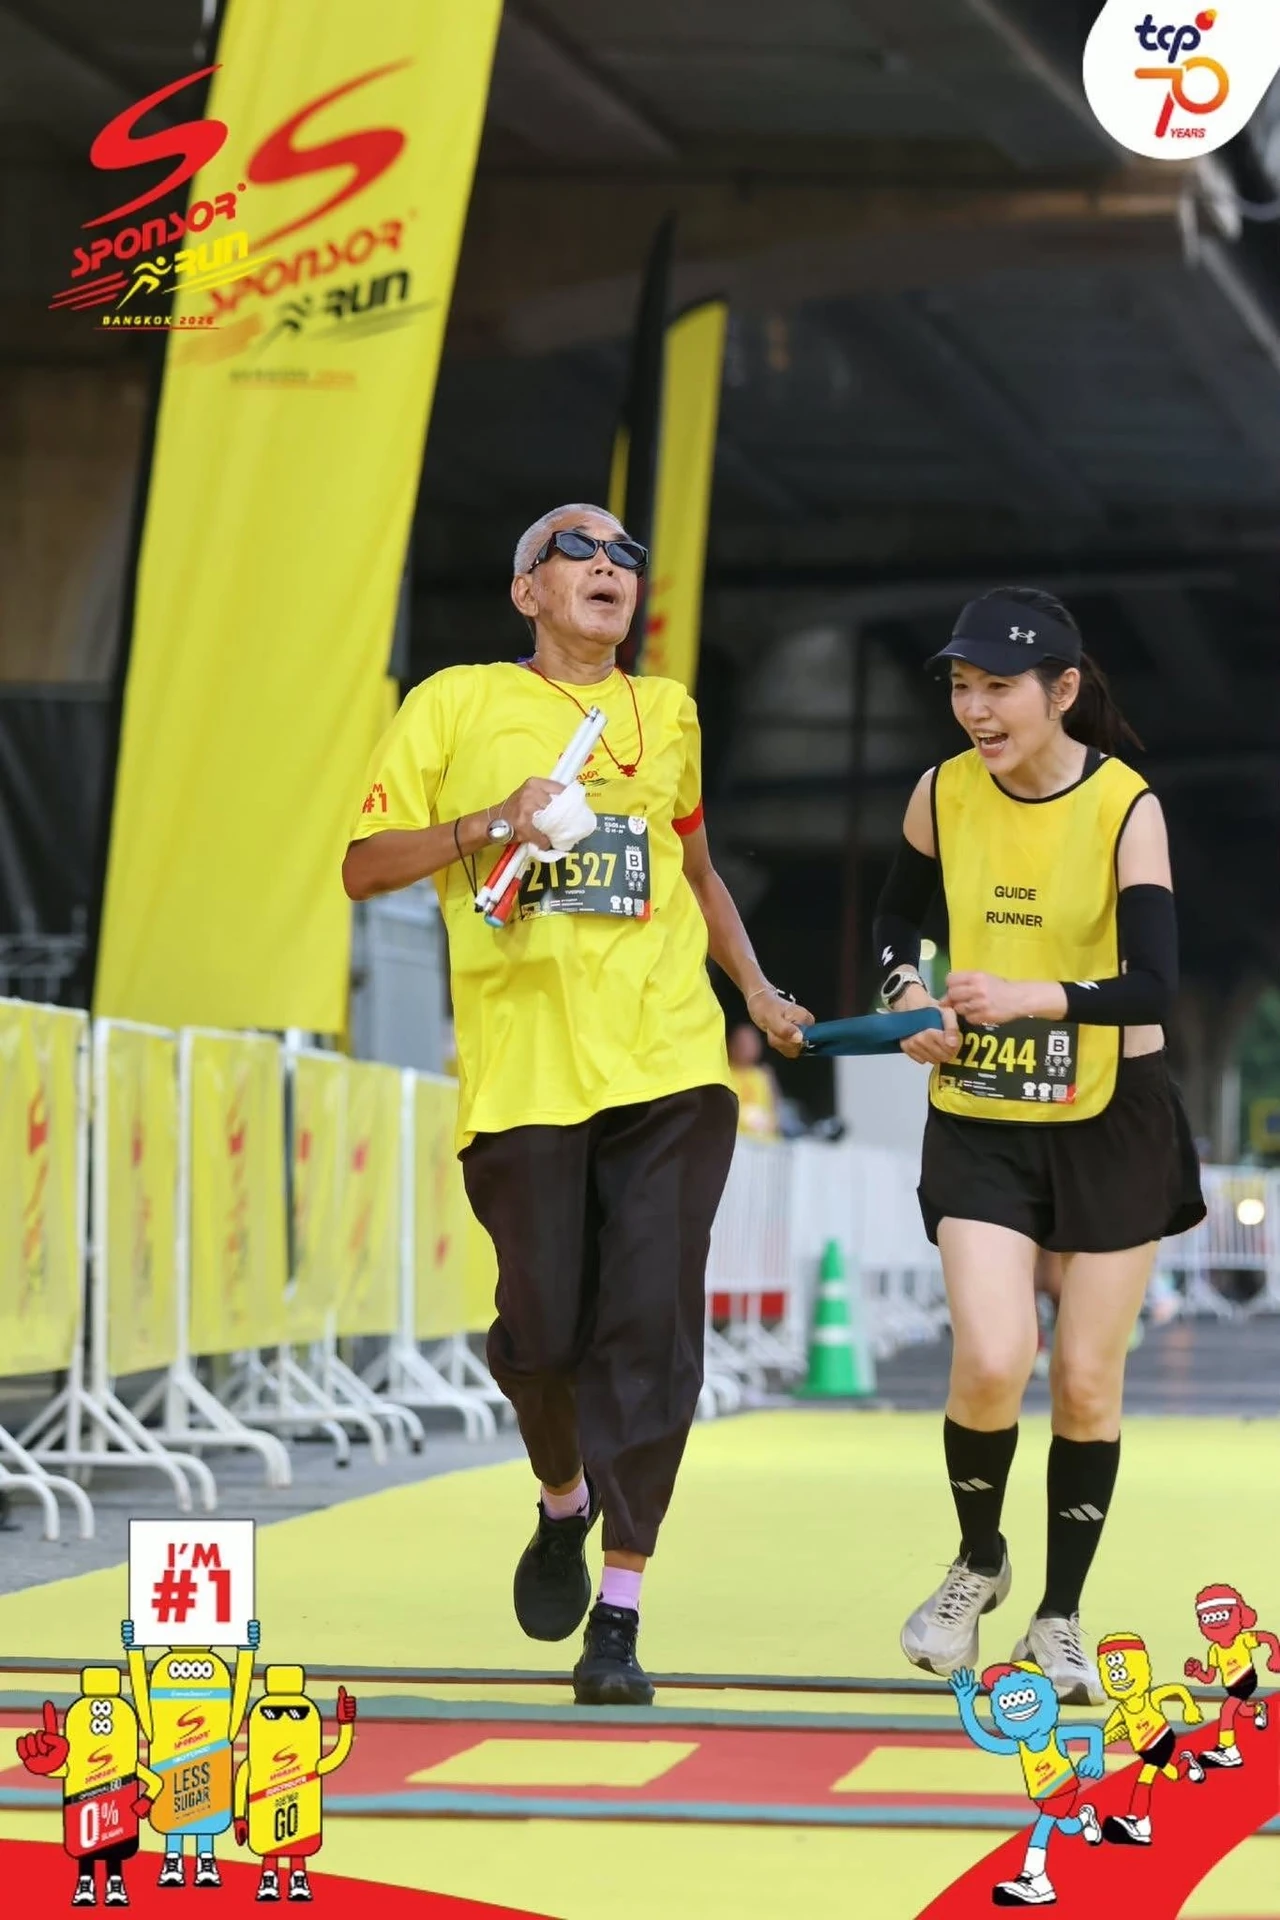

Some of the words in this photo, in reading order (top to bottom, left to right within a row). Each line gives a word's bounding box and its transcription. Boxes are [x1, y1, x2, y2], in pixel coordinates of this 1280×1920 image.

[325, 268, 410, 318] RUN
[362, 793, 387, 813] #1
[630, 854, 640, 868] B
[525, 852, 617, 892] 21527
[994, 885, 1037, 901] GUIDE
[986, 911, 1043, 928] RUNNER
[1053, 1039, 1065, 1052] B
